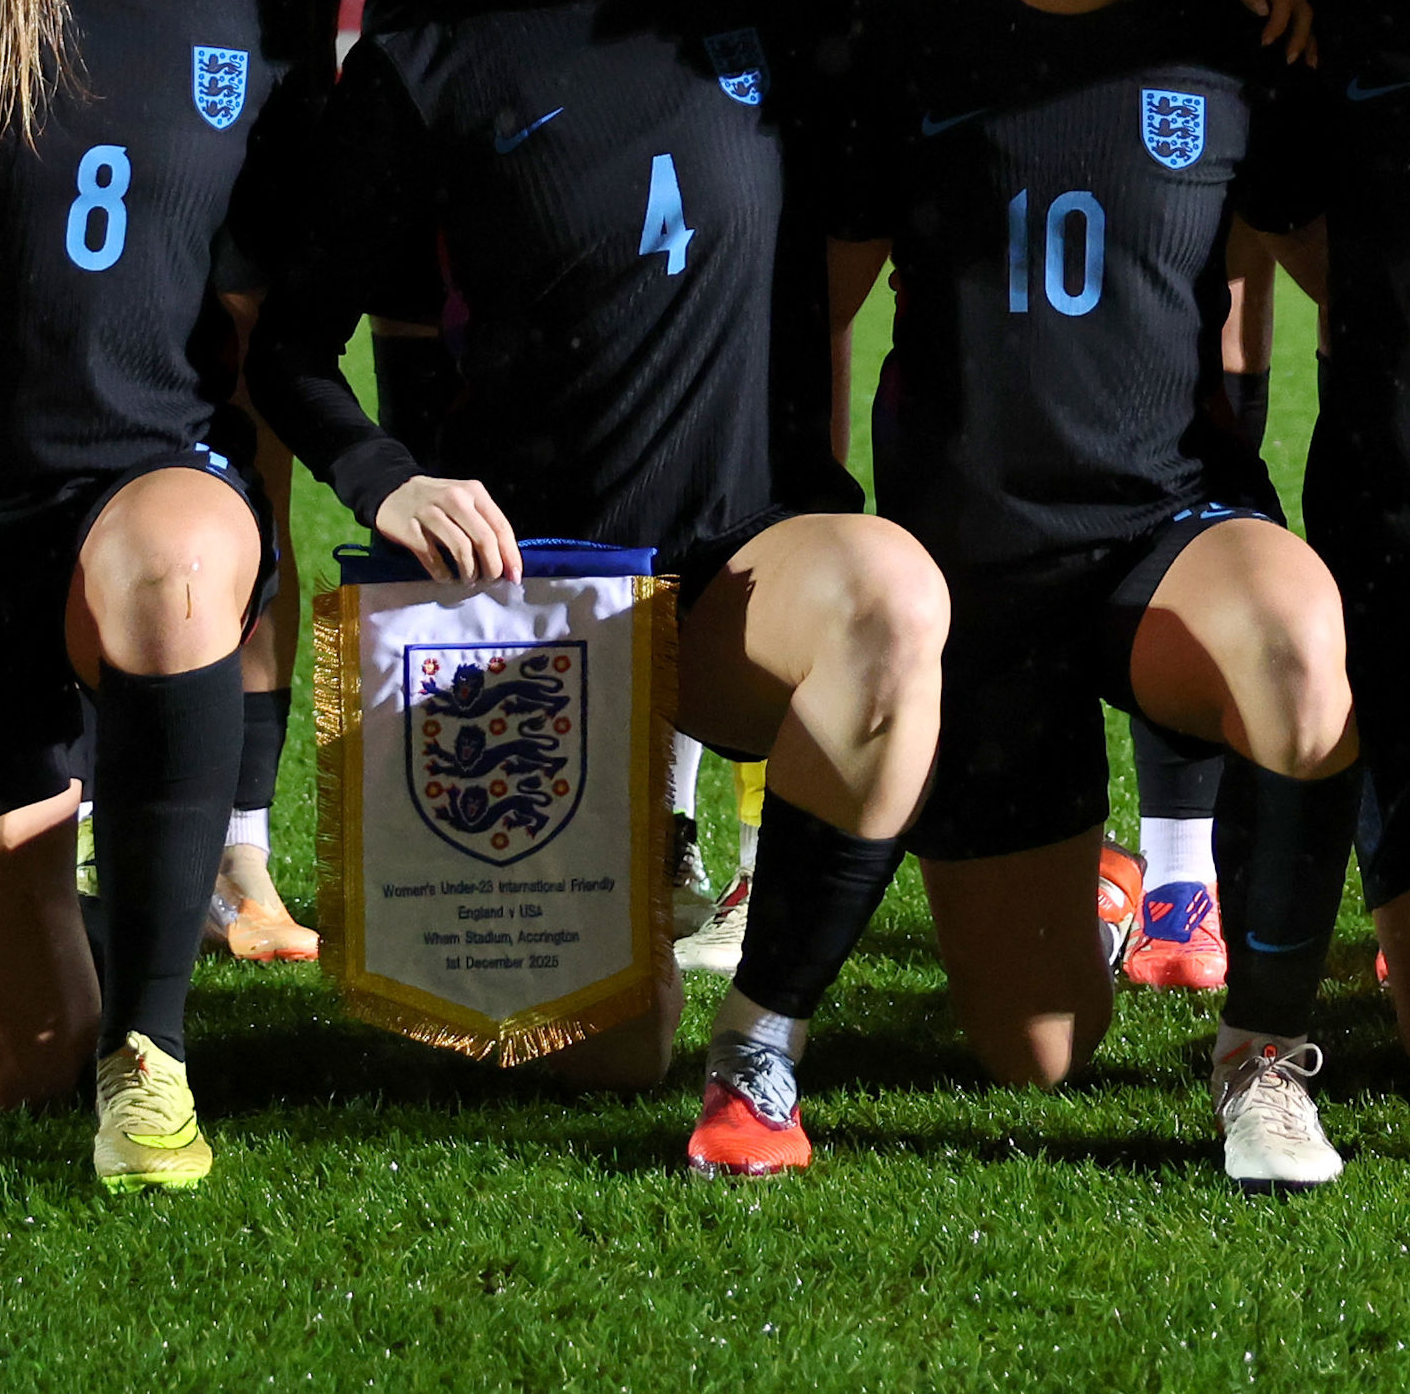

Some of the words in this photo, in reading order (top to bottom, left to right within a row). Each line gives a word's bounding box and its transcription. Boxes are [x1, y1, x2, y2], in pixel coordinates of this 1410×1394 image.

[64, 143, 134, 273] 8
[638, 151, 697, 277] 4
[1008, 189, 1107, 317] 10
[383, 882, 436, 899] Women's
[441, 880, 494, 895] Under-23
[498, 879, 566, 894] International
[570, 877, 615, 894] Friendly
[458, 905, 504, 922] England
[509, 907, 515, 919] v
[519, 904, 543, 919] USA
[423, 931, 460, 945] Wham
[465, 930, 513, 946] Stadium,
[517, 929, 580, 946] Accrington
[466, 954, 524, 969] December
